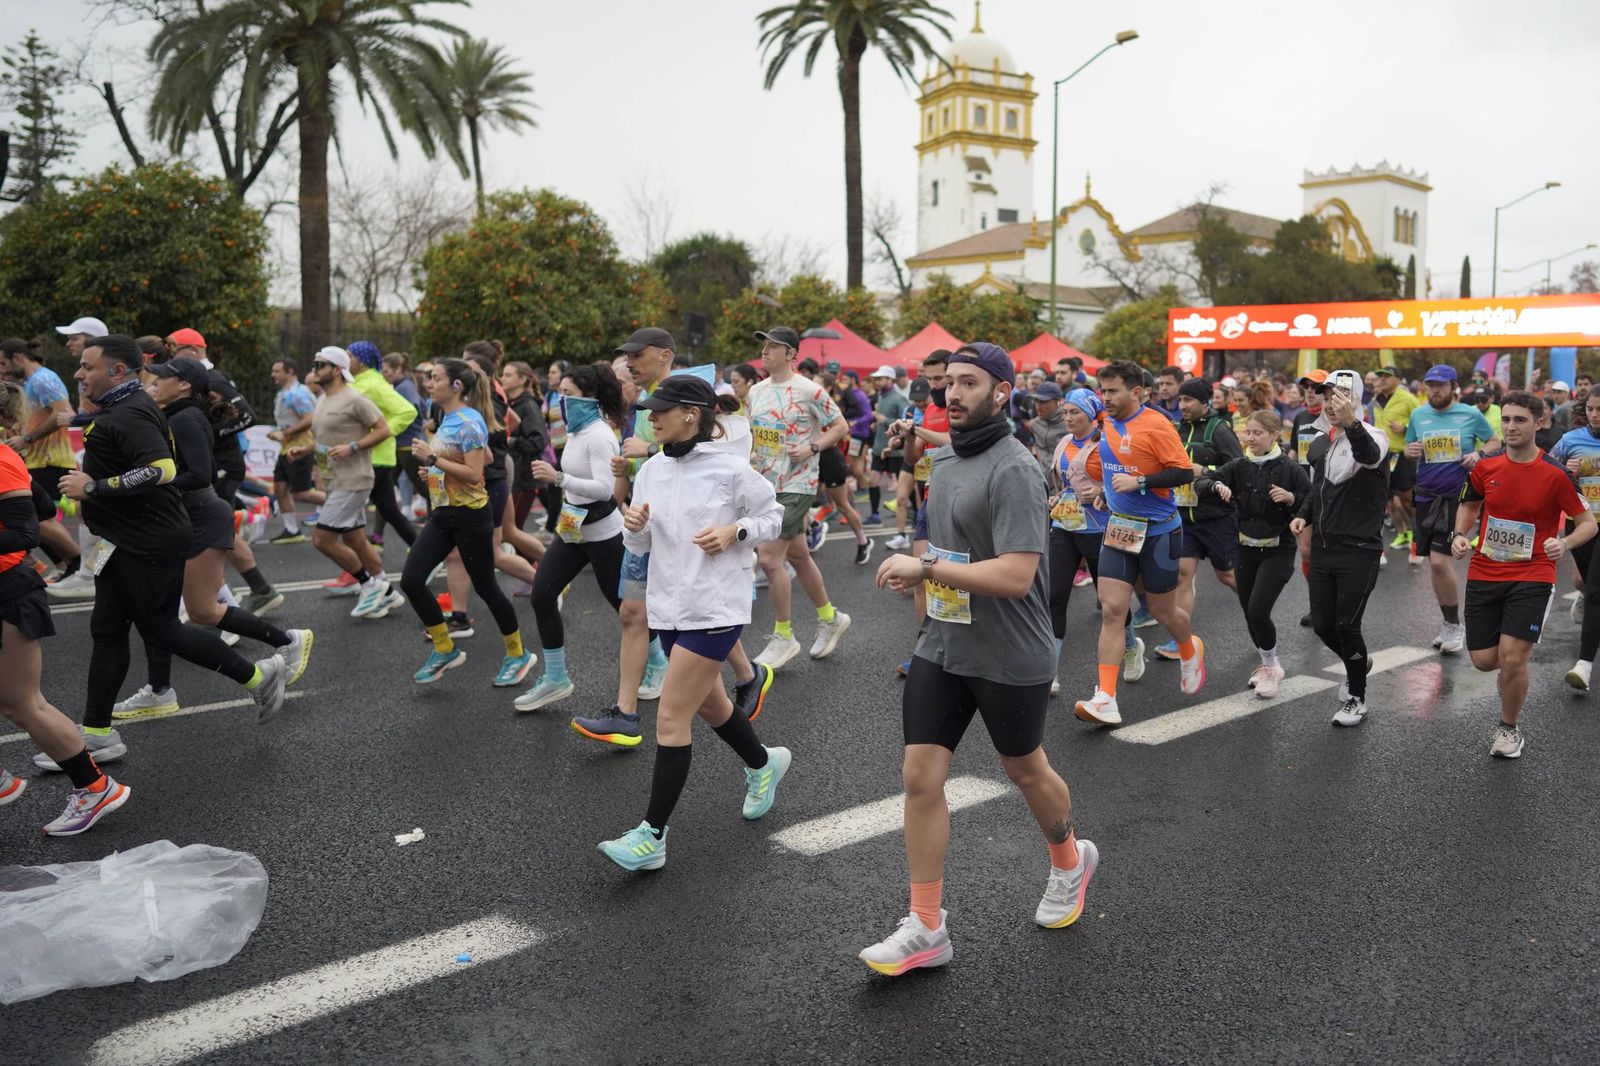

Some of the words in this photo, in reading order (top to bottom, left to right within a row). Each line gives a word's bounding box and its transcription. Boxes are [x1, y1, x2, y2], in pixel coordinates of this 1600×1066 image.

[755, 428, 780, 443] 14338
[1426, 438, 1454, 449] 18671
[1110, 528, 1135, 544] 4724
[1487, 528, 1525, 547] 20384
